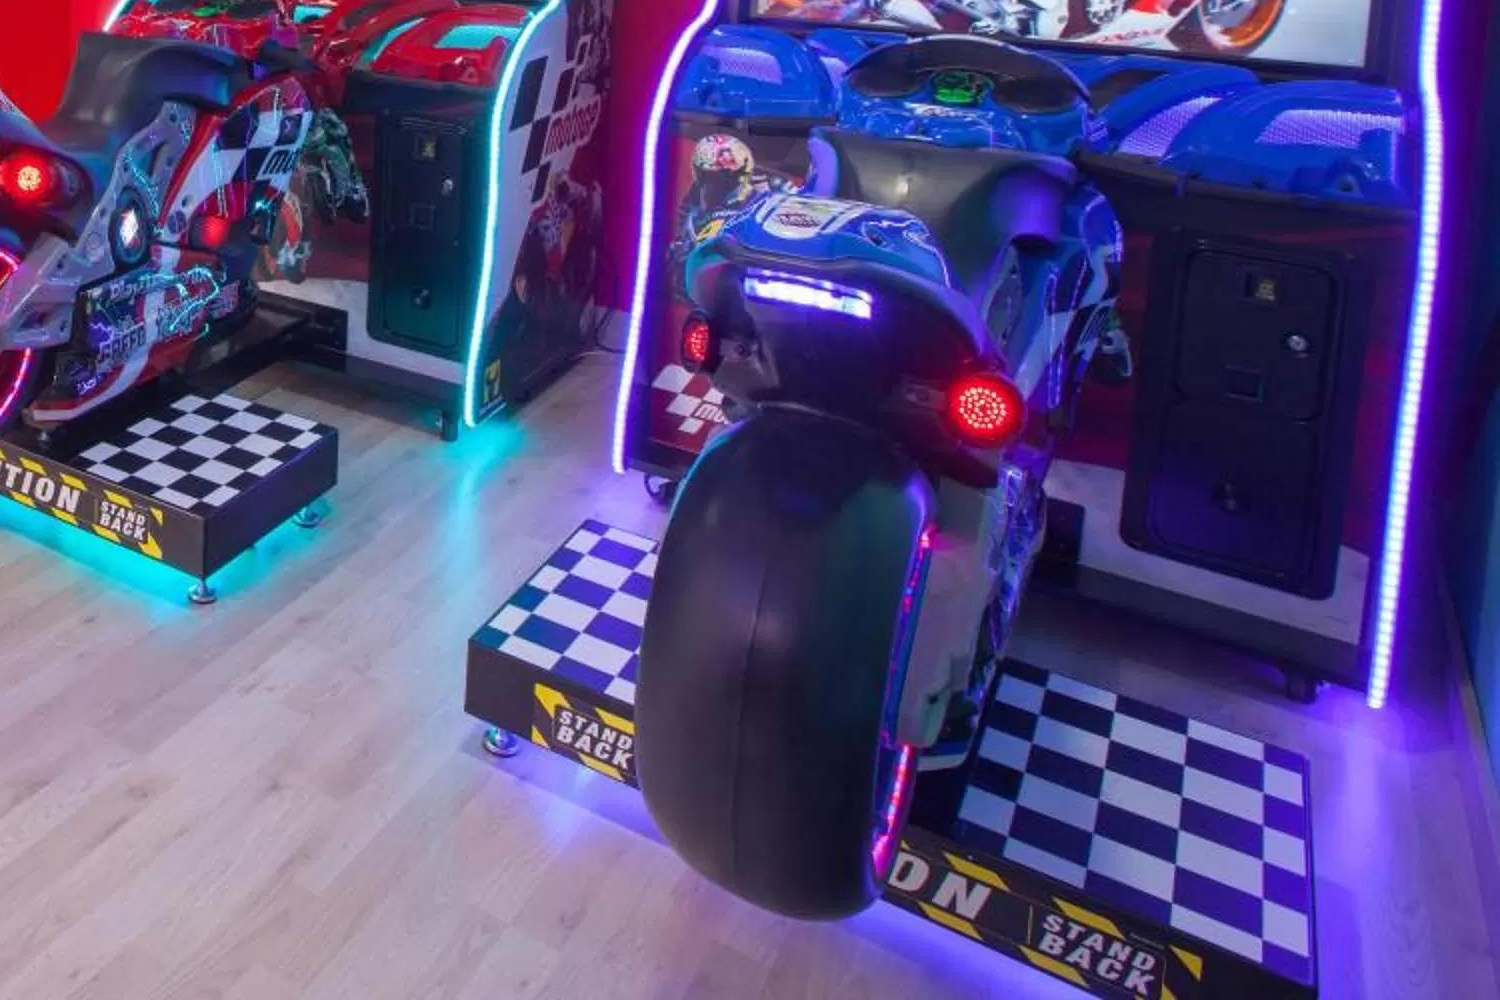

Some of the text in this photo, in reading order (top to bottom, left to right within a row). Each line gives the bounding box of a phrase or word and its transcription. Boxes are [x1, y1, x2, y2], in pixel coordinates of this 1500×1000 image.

[99, 513, 147, 542] BACK
[101, 500, 147, 526] STAND
[556, 726, 633, 771] BACK
[558, 710, 633, 751] STAND
[1042, 913, 1156, 971] STAND
[1038, 932, 1155, 996] BACK
